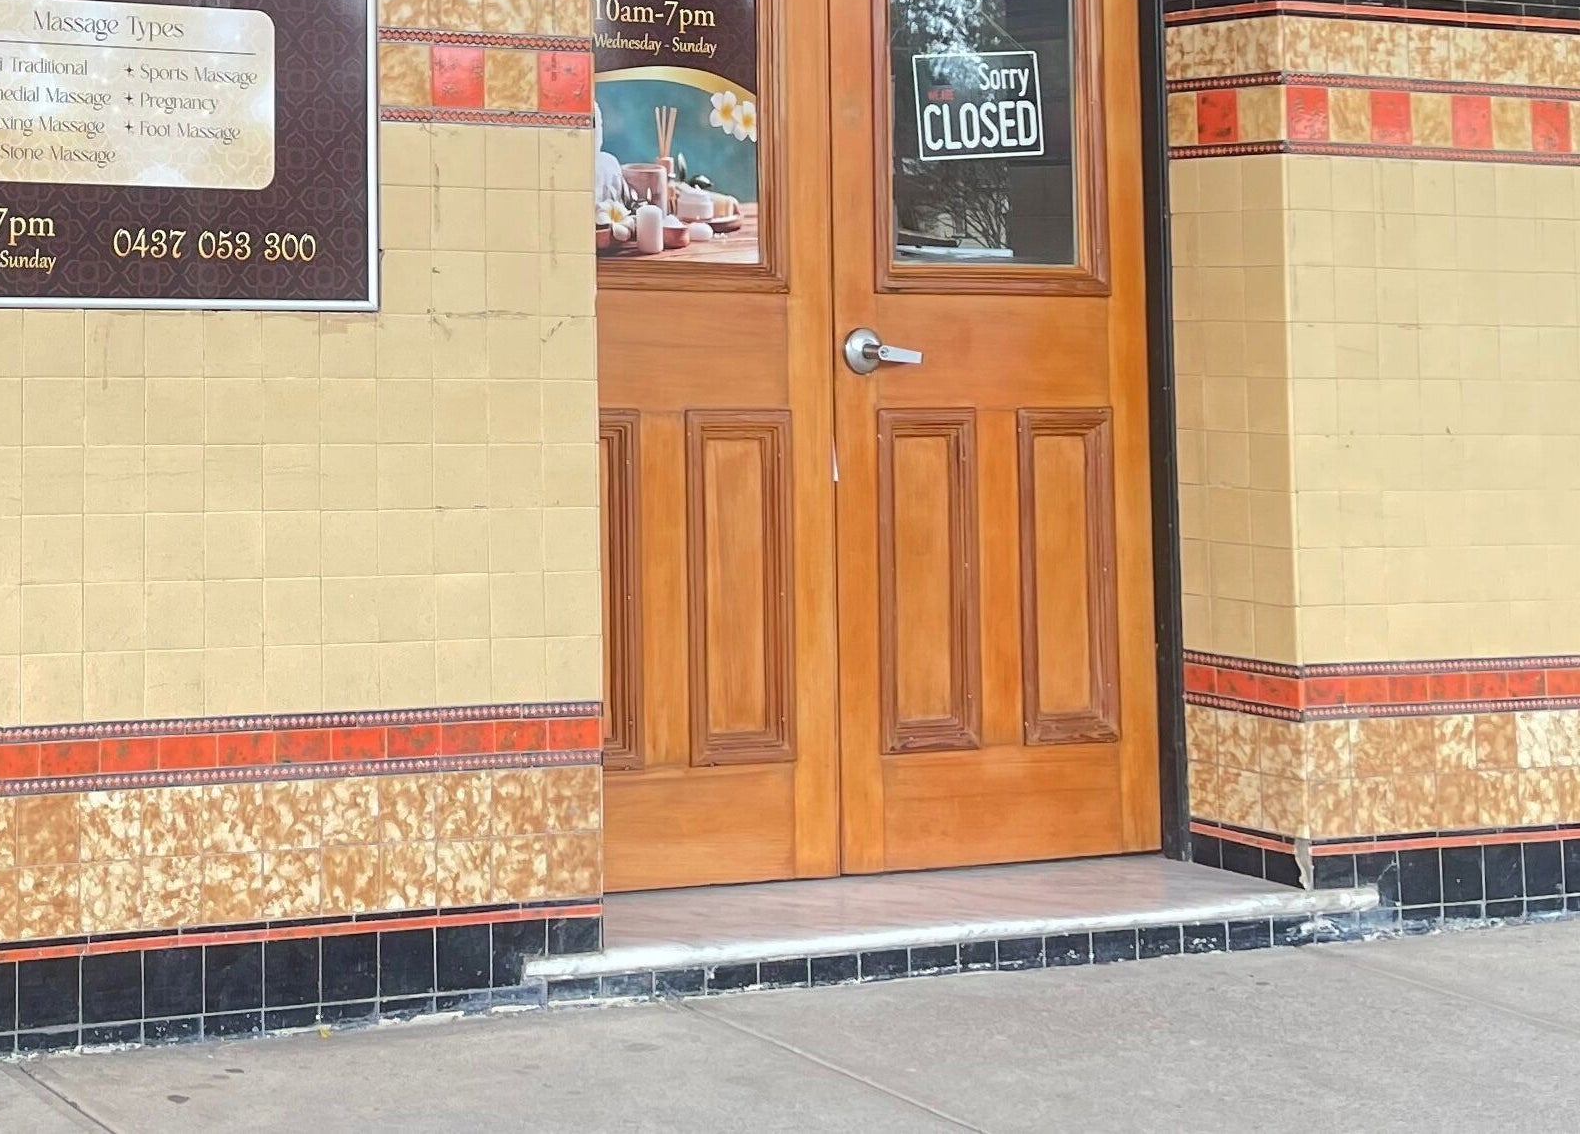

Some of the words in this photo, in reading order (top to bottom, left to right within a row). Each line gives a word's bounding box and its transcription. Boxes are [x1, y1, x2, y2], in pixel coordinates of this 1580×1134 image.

[33, 10, 119, 41] Massage
[126, 15, 185, 41] Types
[593, 32, 662, 56] Wednesday
[672, 36, 717, 58] Sunday
[9, 56, 88, 76] Traditional
[140, 63, 189, 87] Sports
[194, 66, 258, 90] Massage
[978, 63, 1030, 97] Sorry
[46, 87, 112, 108] Massage
[140, 92, 218, 115] Pregnancy
[39, 115, 106, 139] Massage
[139, 120, 172, 138] Foot
[177, 122, 241, 145] Massage
[923, 100, 1038, 151] CLOSED
[0, 142, 44, 161] Stone
[50, 145, 117, 168] Massage
[113, 228, 186, 260] 0437
[198, 230, 252, 261] 053
[263, 232, 316, 262] 300
[0, 248, 57, 274] Sunday
